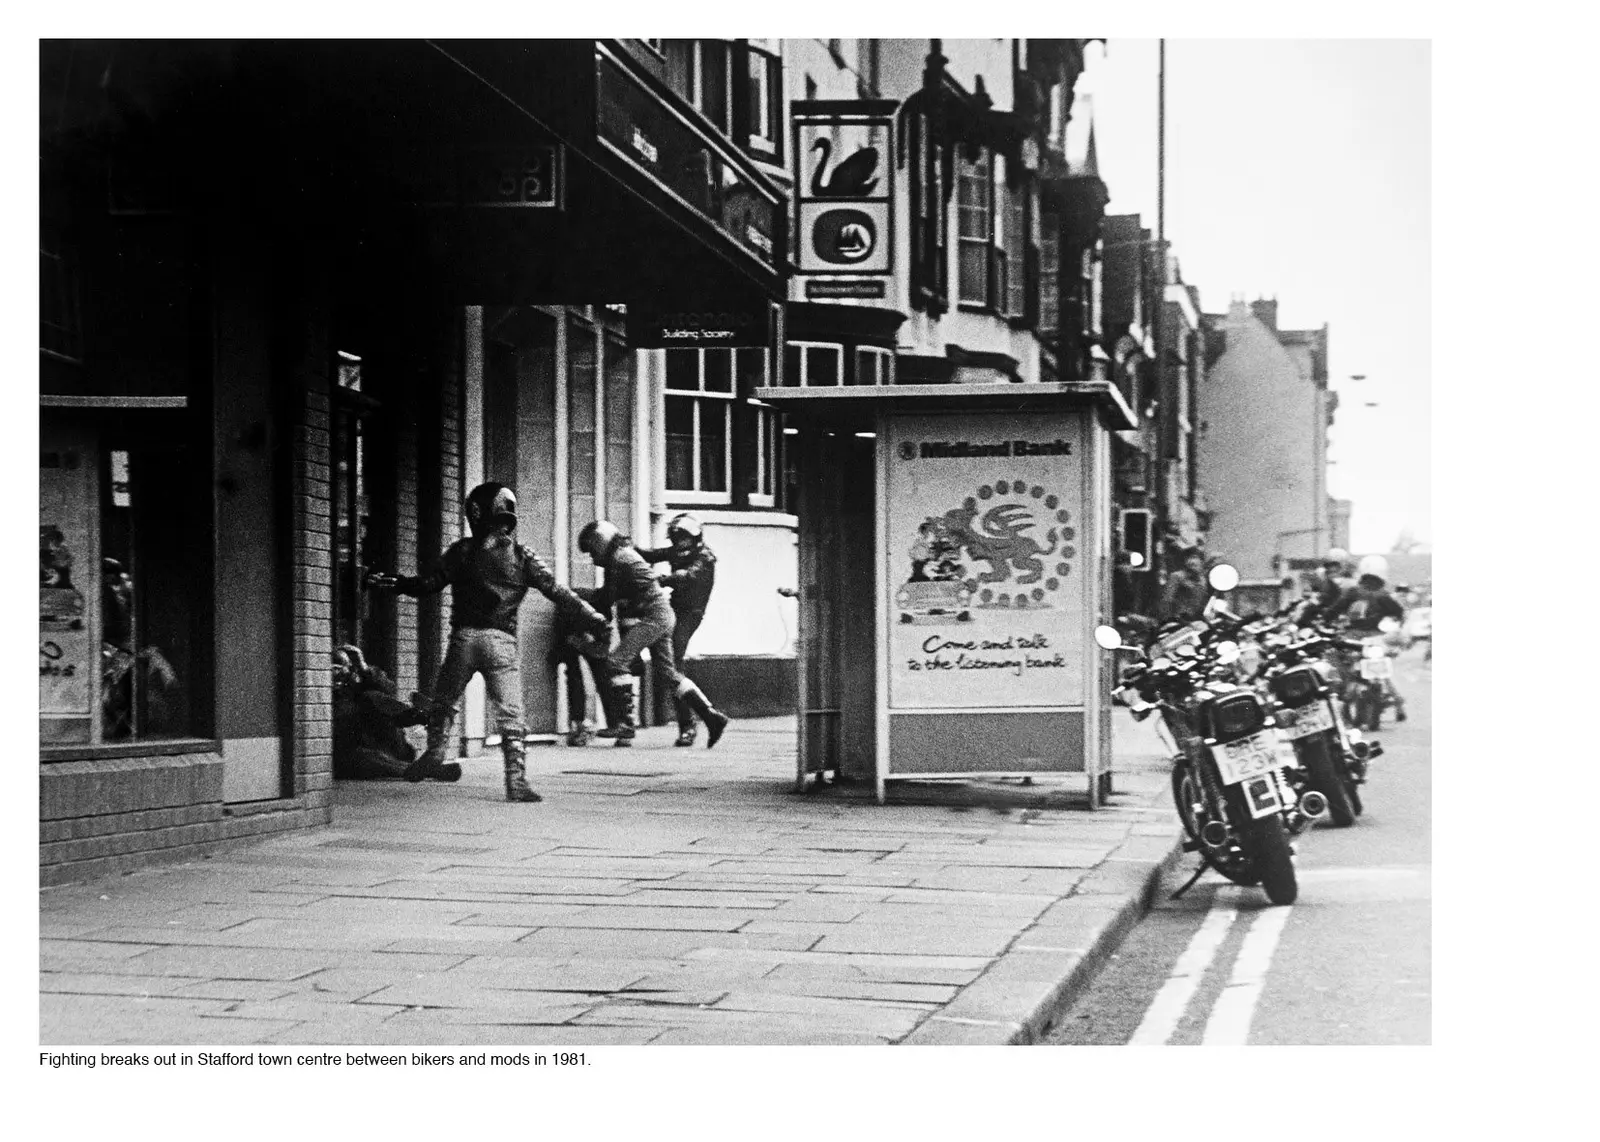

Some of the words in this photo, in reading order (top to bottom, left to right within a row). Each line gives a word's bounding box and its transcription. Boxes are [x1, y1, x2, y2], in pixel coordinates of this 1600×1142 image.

[662, 328, 699, 340] Building
[919, 441, 1011, 458] Midland
[1013, 439, 1072, 456] Bank
[922, 634, 978, 653] Come
[980, 635, 1014, 651] and
[1016, 633, 1049, 650] talk
[907, 657, 922, 671] to
[925, 654, 953, 671] the
[955, 653, 1022, 677] listening
[1024, 652, 1066, 669] bank
